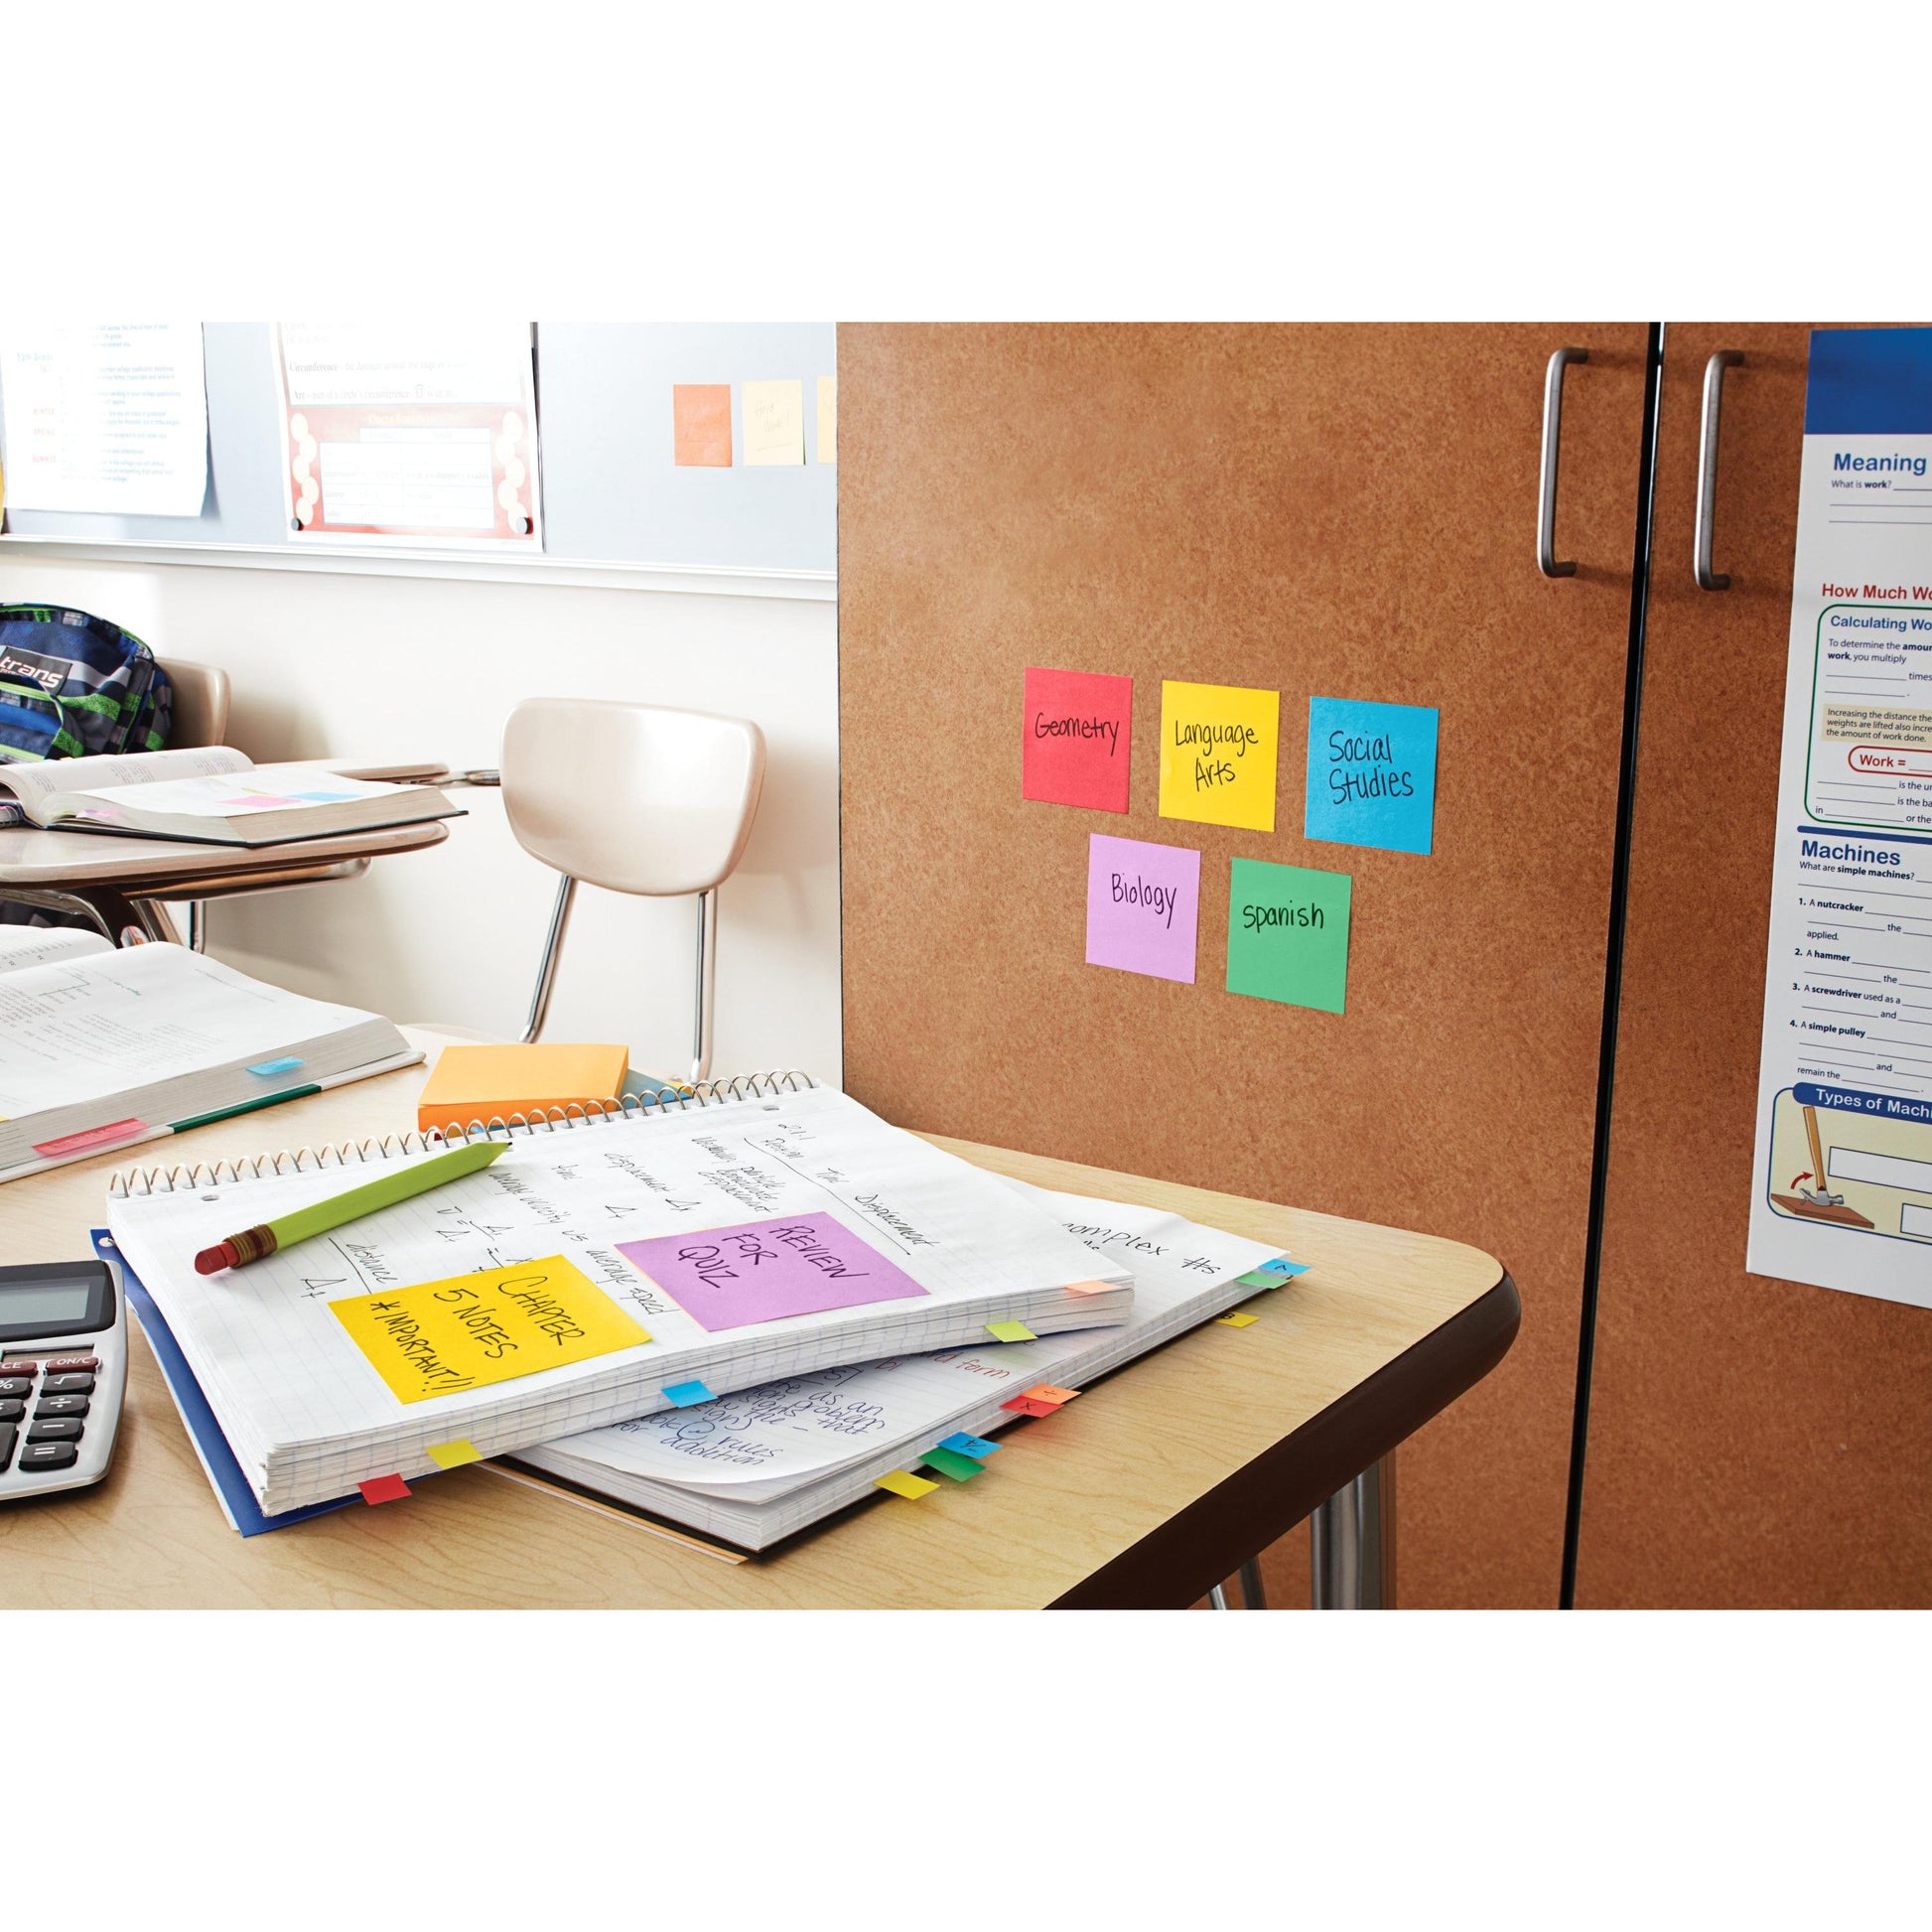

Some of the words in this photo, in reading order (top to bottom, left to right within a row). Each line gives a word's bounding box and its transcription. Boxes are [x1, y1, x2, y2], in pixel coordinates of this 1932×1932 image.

[1834, 453, 1927, 476] Meaning
[1832, 480, 1854, 488] What
[1856, 480, 1863, 488] is
[1864, 480, 1891, 489] work?
[1822, 583, 1859, 598] How
[1863, 585, 1907, 600] Much
[1830, 616, 1907, 632] Calculating
[1829, 638, 1838, 647] To
[1841, 638, 1884, 649] determine
[1886, 641, 1900, 650] the
[1828, 652, 1852, 661] work,
[1854, 654, 1869, 663] you
[1871, 654, 1906, 665] multiply
[1828, 708, 1867, 720] Increasing
[1869, 710, 1882, 719] the
[1883, 712, 1917, 722] distance
[1035, 712, 1120, 757] Geometry
[1827, 719, 1858, 729] weights
[1873, 721, 1894, 731] lifted
[1174, 720, 1259, 757] Language
[1841, 731, 1871, 740] amount
[1873, 731, 1881, 740] of
[1883, 733, 1903, 742] work
[1904, 734, 1927, 743] done.
[1328, 731, 1393, 763] Social
[1860, 754, 1894, 767] Work
[1194, 758, 1236, 791] Arts
[1328, 764, 1415, 805] Studies
[1898, 780, 1906, 789] is
[1906, 798, 1921, 807] the
[1917, 815, 1932, 824] the
[1801, 840, 1901, 866] Machines
[1800, 861, 1821, 871] What
[1837, 866, 1866, 877] simple
[1867, 869, 1915, 881] machines?
[1111, 873, 1177, 929] Biology
[1798, 897, 1807, 906] 1.
[1817, 900, 1863, 912] nutcracker
[1807, 930, 1840, 941] applied.
[1887, 923, 1902, 932] the
[1814, 950, 1851, 962] hammer
[1883, 975, 1898, 984] the
[1792, 983, 1801, 992] 3.
[1804, 984, 1811, 993] A
[1812, 986, 1863, 1000] screwdriver
[1863, 993, 1883, 1003] used
[1880, 1011, 1897, 1020] and
[1789, 1020, 1798, 1029] 4.
[1801, 1021, 1808, 1030] A
[1809, 1023, 1838, 1035] simple
[1839, 1027, 1866, 1039] pulley
[1797, 1066, 1826, 1077] remain
[1827, 1070, 1841, 1080] the
[1876, 1063, 1892, 1072] and
[1816, 1088, 1863, 1108] Types
[1865, 1097, 1883, 1111] of
[721, 1233, 778, 1266] FOR
[768, 1225, 870, 1280] REVIEW
[345, 1242, 398, 1285] distance
[586, 1248, 638, 1285] average
[677, 1245, 740, 1289] QUIZ
[433, 1288, 479, 1303] 5
[498, 1276, 586, 1346] CHAPTER
[453, 1305, 519, 1358] NOTES
[56, 1357, 91, 1366] ON/C
[955, 1359, 1011, 1379] form
[809, 1391, 843, 1405] as
[847, 1402, 884, 1416] an
[781, 1400, 886, 1430] problem
[817, 1418, 869, 1436] that
[659, 1436, 764, 1466] addition
[718, 1436, 783, 1457] rules
